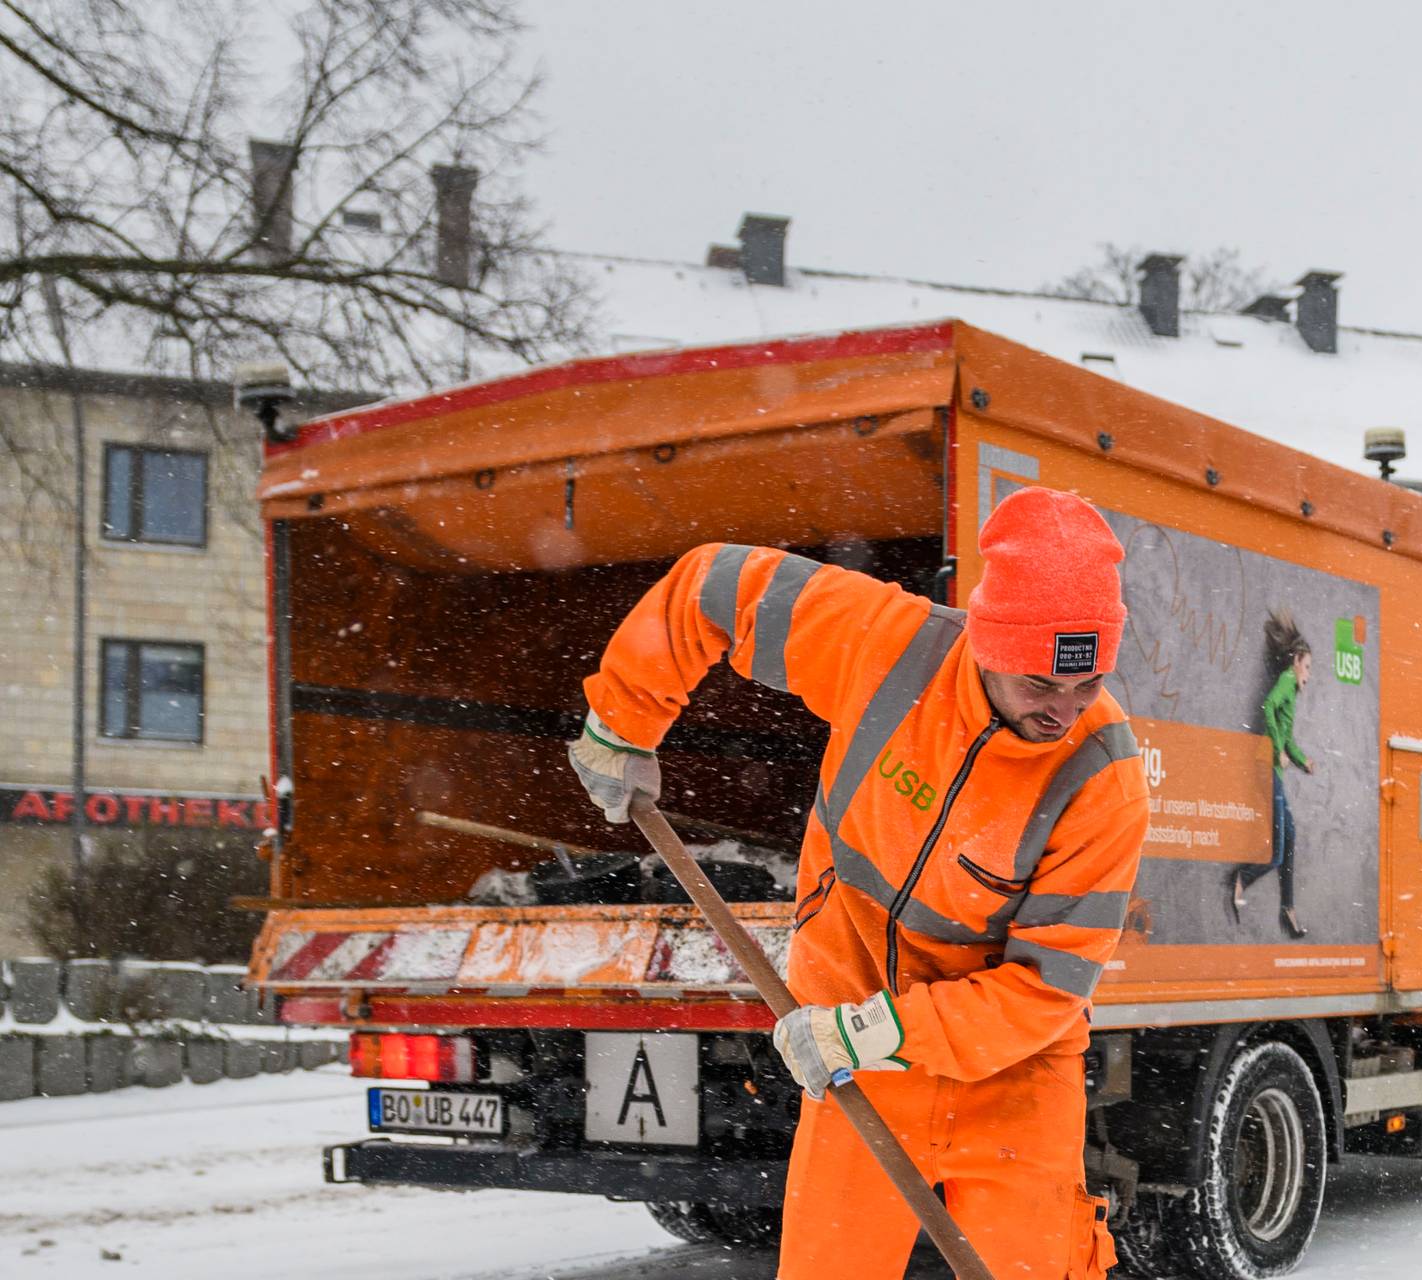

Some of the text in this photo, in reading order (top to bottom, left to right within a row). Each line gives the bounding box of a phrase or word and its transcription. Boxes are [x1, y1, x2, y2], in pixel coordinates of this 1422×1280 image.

[1336, 651, 1361, 680] USB
[879, 749, 937, 811] USB
[1139, 738, 1166, 787] ig.
[382, 1094, 498, 1128] BO UB 447
[617, 1046, 667, 1127] A
